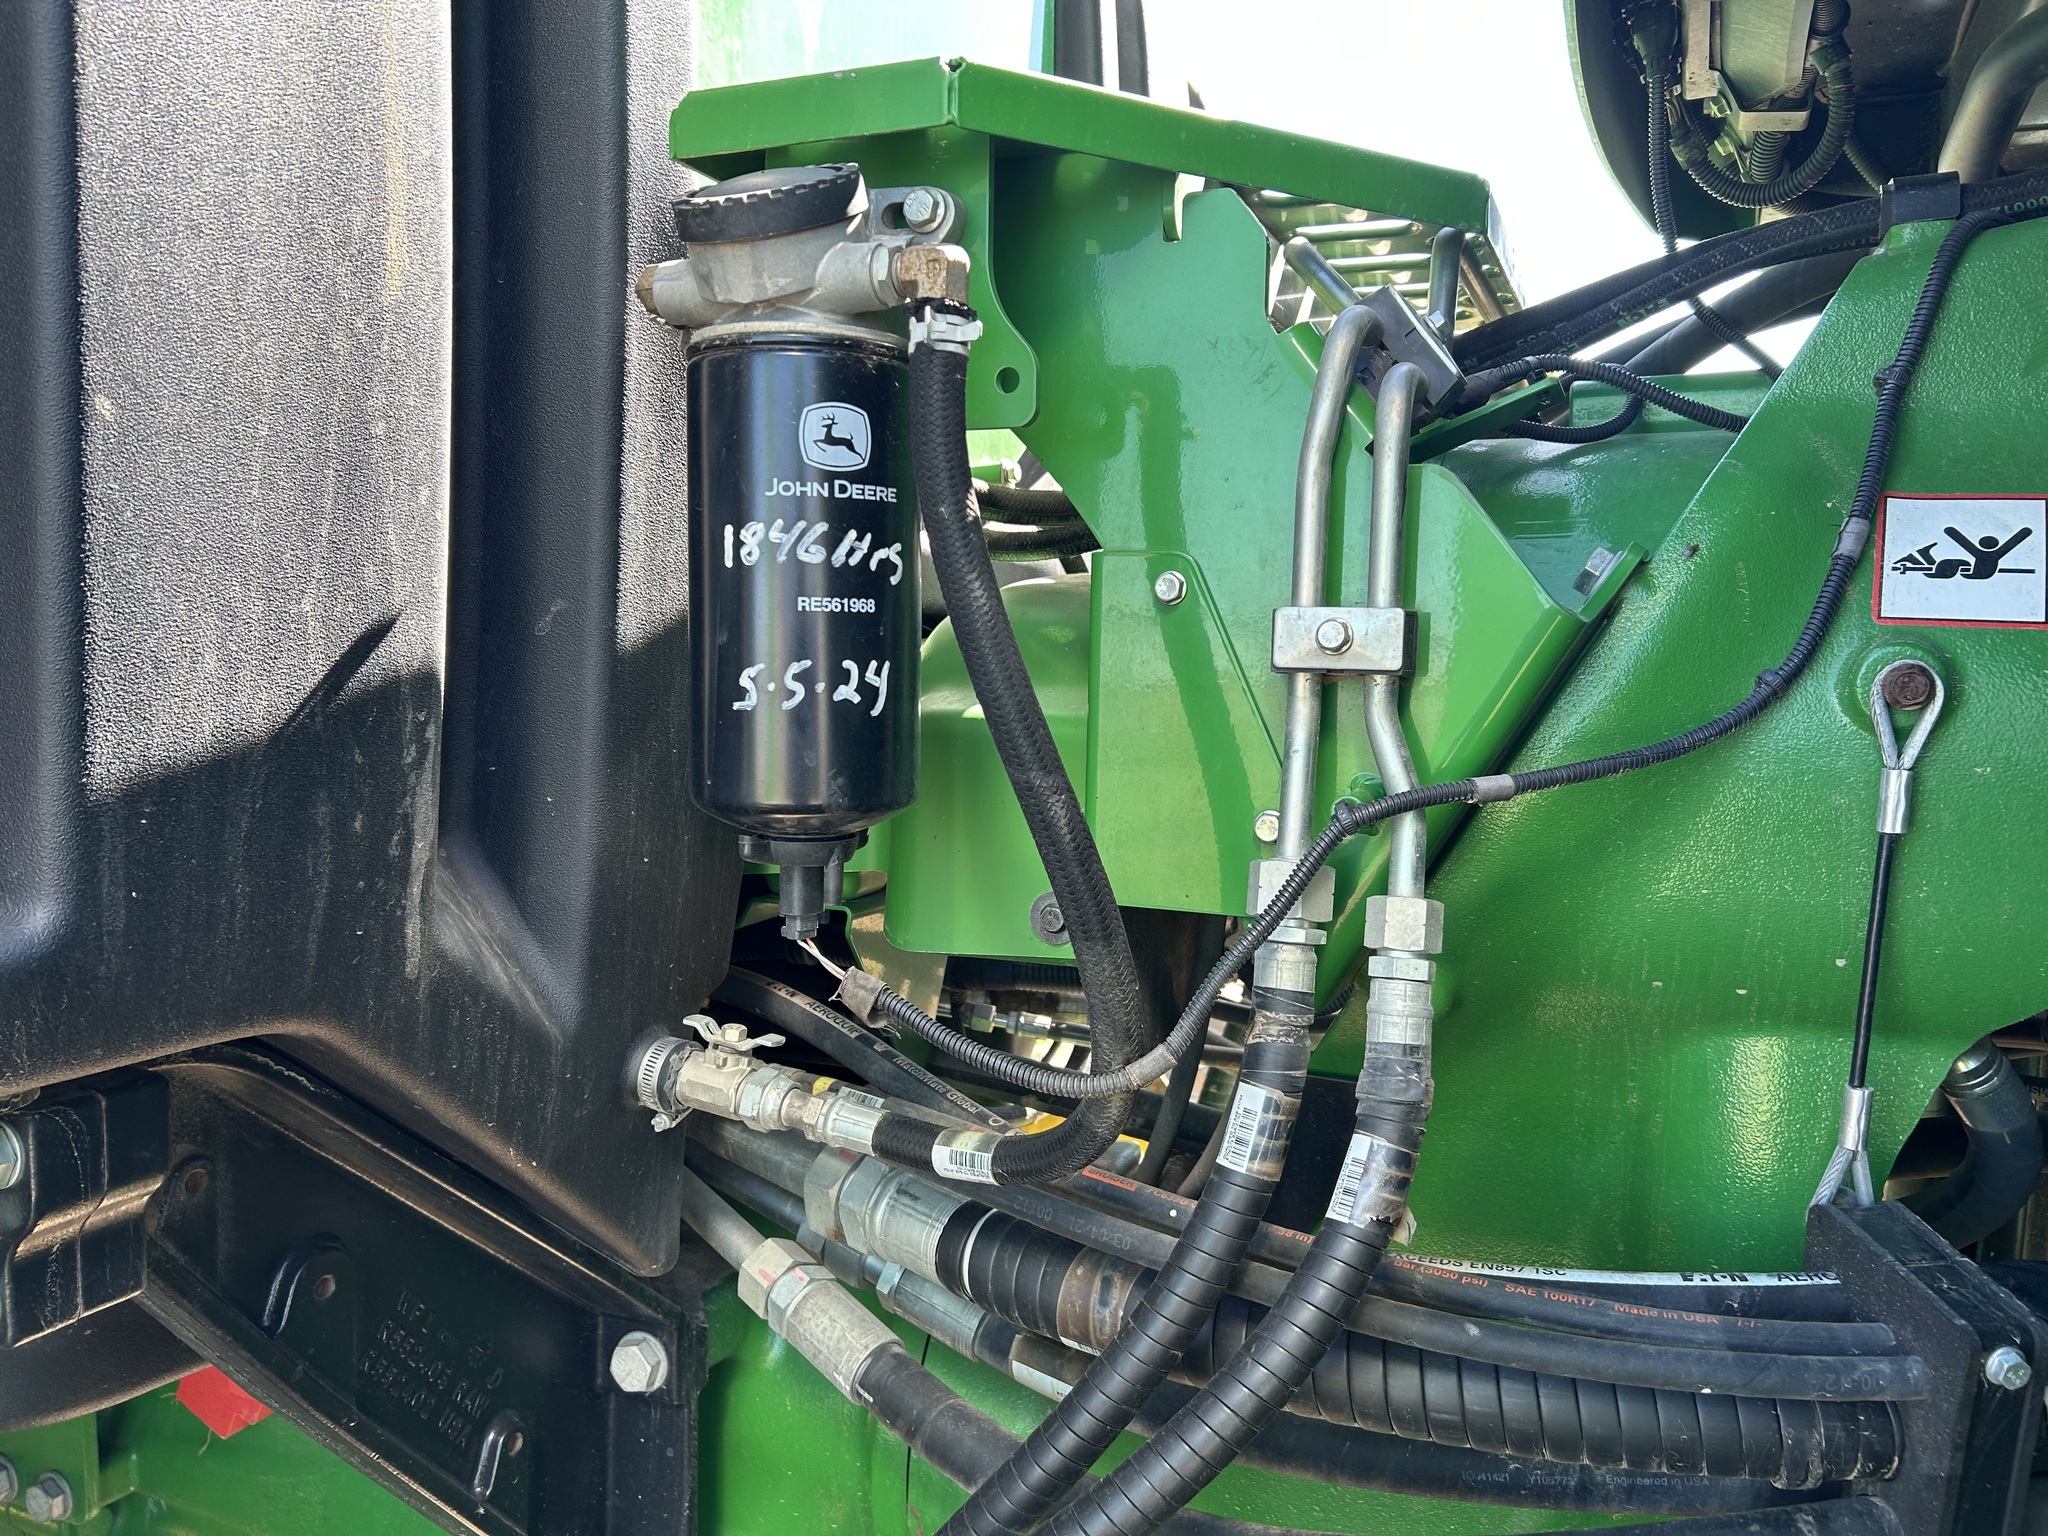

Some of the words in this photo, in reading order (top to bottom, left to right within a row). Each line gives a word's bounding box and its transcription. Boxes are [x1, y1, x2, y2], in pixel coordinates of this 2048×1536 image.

[765, 478, 829, 498] JOHN
[833, 479, 898, 503] DEERE
[723, 518, 829, 569] 1846
[797, 596, 876, 613] RE561968
[805, 1000, 865, 1036] AEROQUIP
[893, 1055, 947, 1094] MatchMate
[946, 1090, 981, 1115] Global
[1088, 1167, 1136, 1188] BRUISER
[1393, 1259, 1415, 1270] bar
[1420, 1266, 1459, 1280] (3050
[1461, 1274, 1489, 1288] psi)
[1505, 1283, 1537, 1297] SAE
[1542, 1290, 1597, 1307] 100R17
[1613, 1302, 1658, 1317] Made
[1663, 1310, 1678, 1320] in
[1682, 1312, 1719, 1325] USA
[1605, 1474, 1668, 1487] Engineered
[1684, 1477, 1710, 1486] USA
